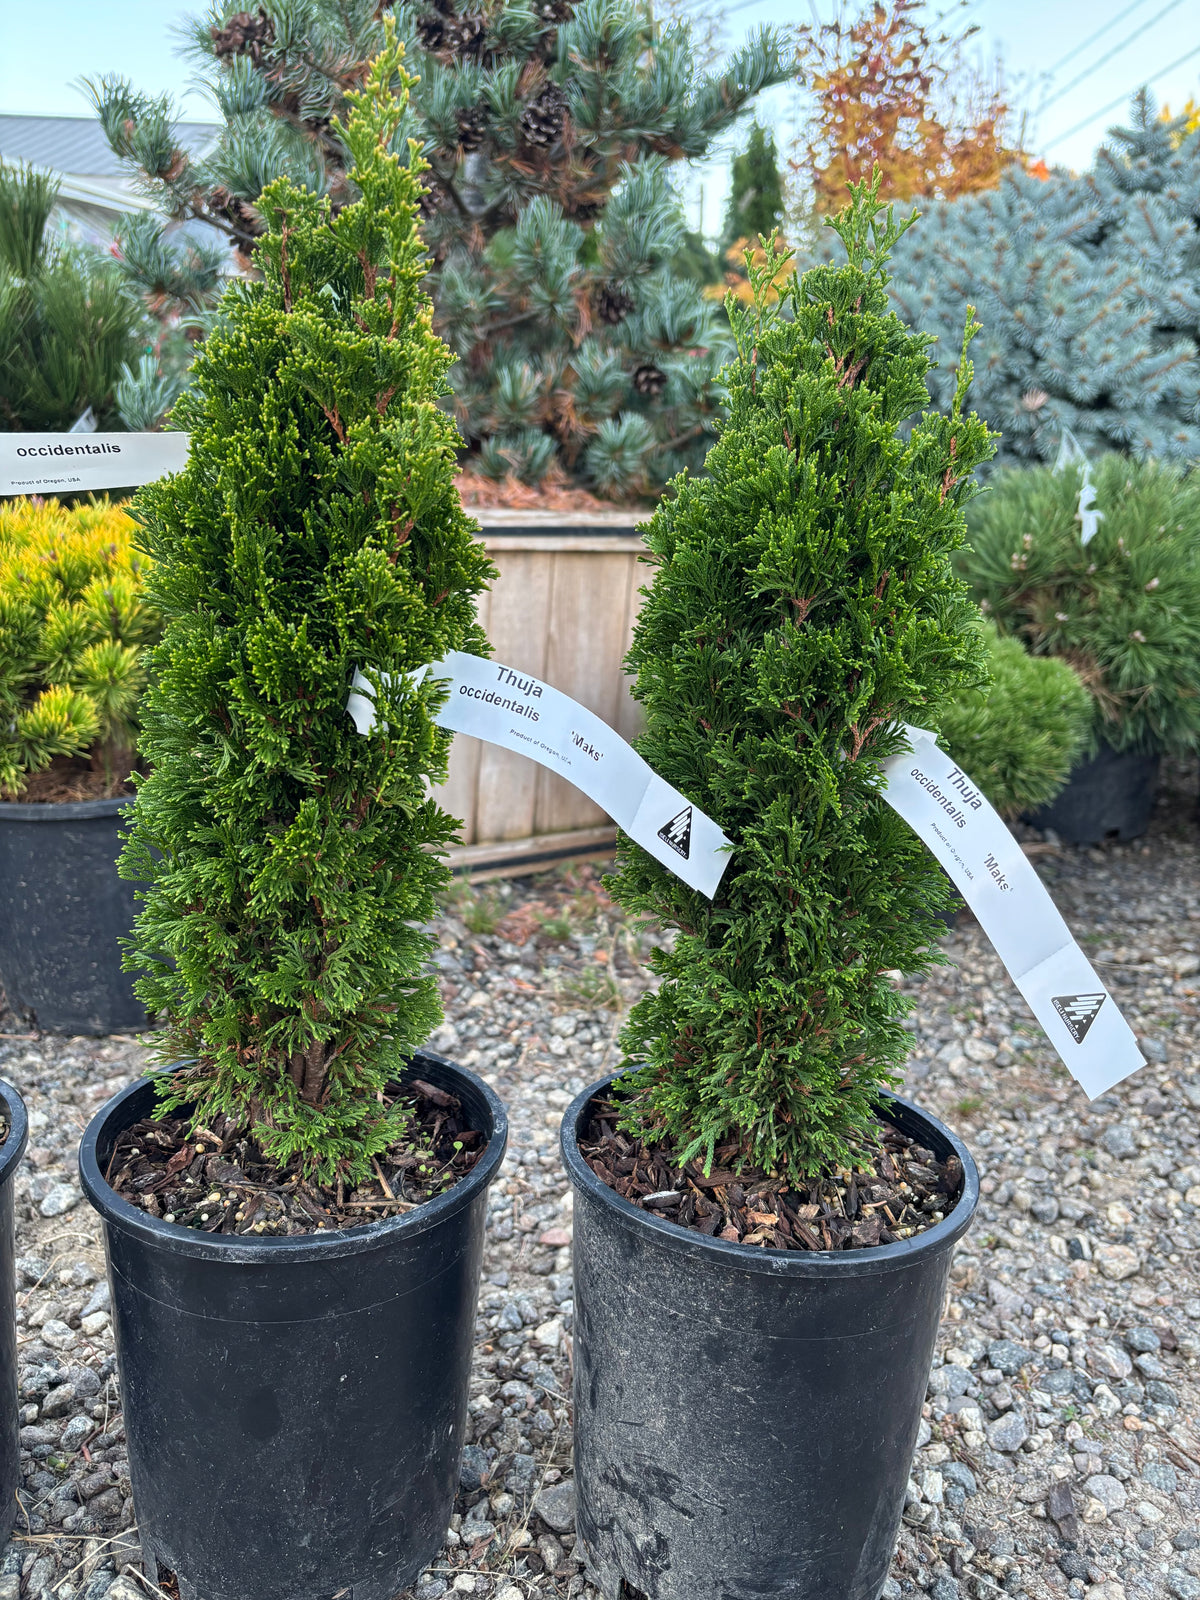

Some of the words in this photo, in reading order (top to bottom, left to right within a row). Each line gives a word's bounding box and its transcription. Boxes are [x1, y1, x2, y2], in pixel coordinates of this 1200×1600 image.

[16, 443, 121, 457] occidentalis
[496, 666, 544, 699] Thuja
[459, 685, 540, 721] occidentalis
[509, 728, 532, 745] Product
[571, 730, 604, 762] 'Maks'
[910, 768, 967, 829] occidentalis
[946, 767, 983, 811] Thuja
[931, 822, 947, 846] Product
[984, 852, 1014, 892] 'Maks'
